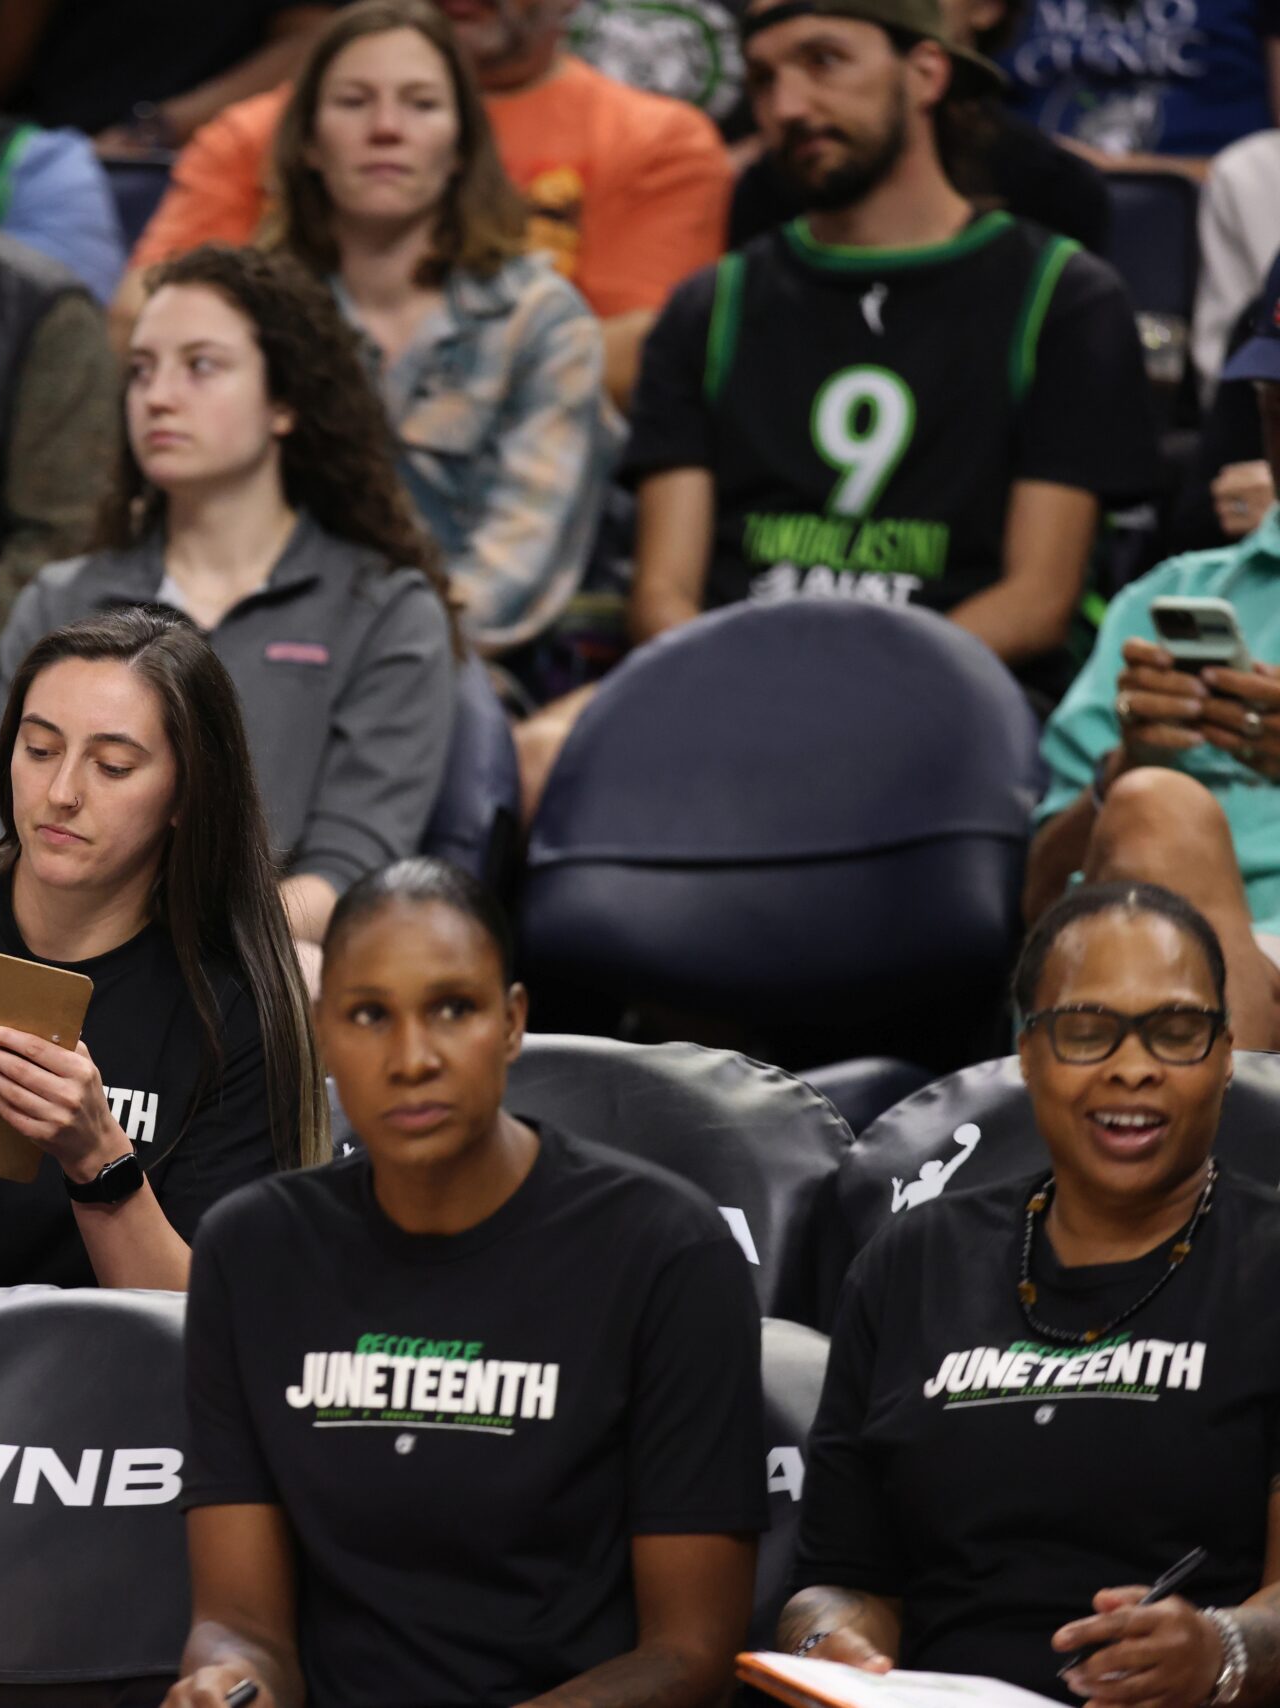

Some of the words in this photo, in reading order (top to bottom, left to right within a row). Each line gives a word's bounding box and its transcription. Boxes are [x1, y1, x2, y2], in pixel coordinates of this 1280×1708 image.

[810, 363, 917, 517] 9
[285, 1352, 560, 1420] JUNETEENTH
[923, 1339, 1206, 1398] JUNETEENTH
